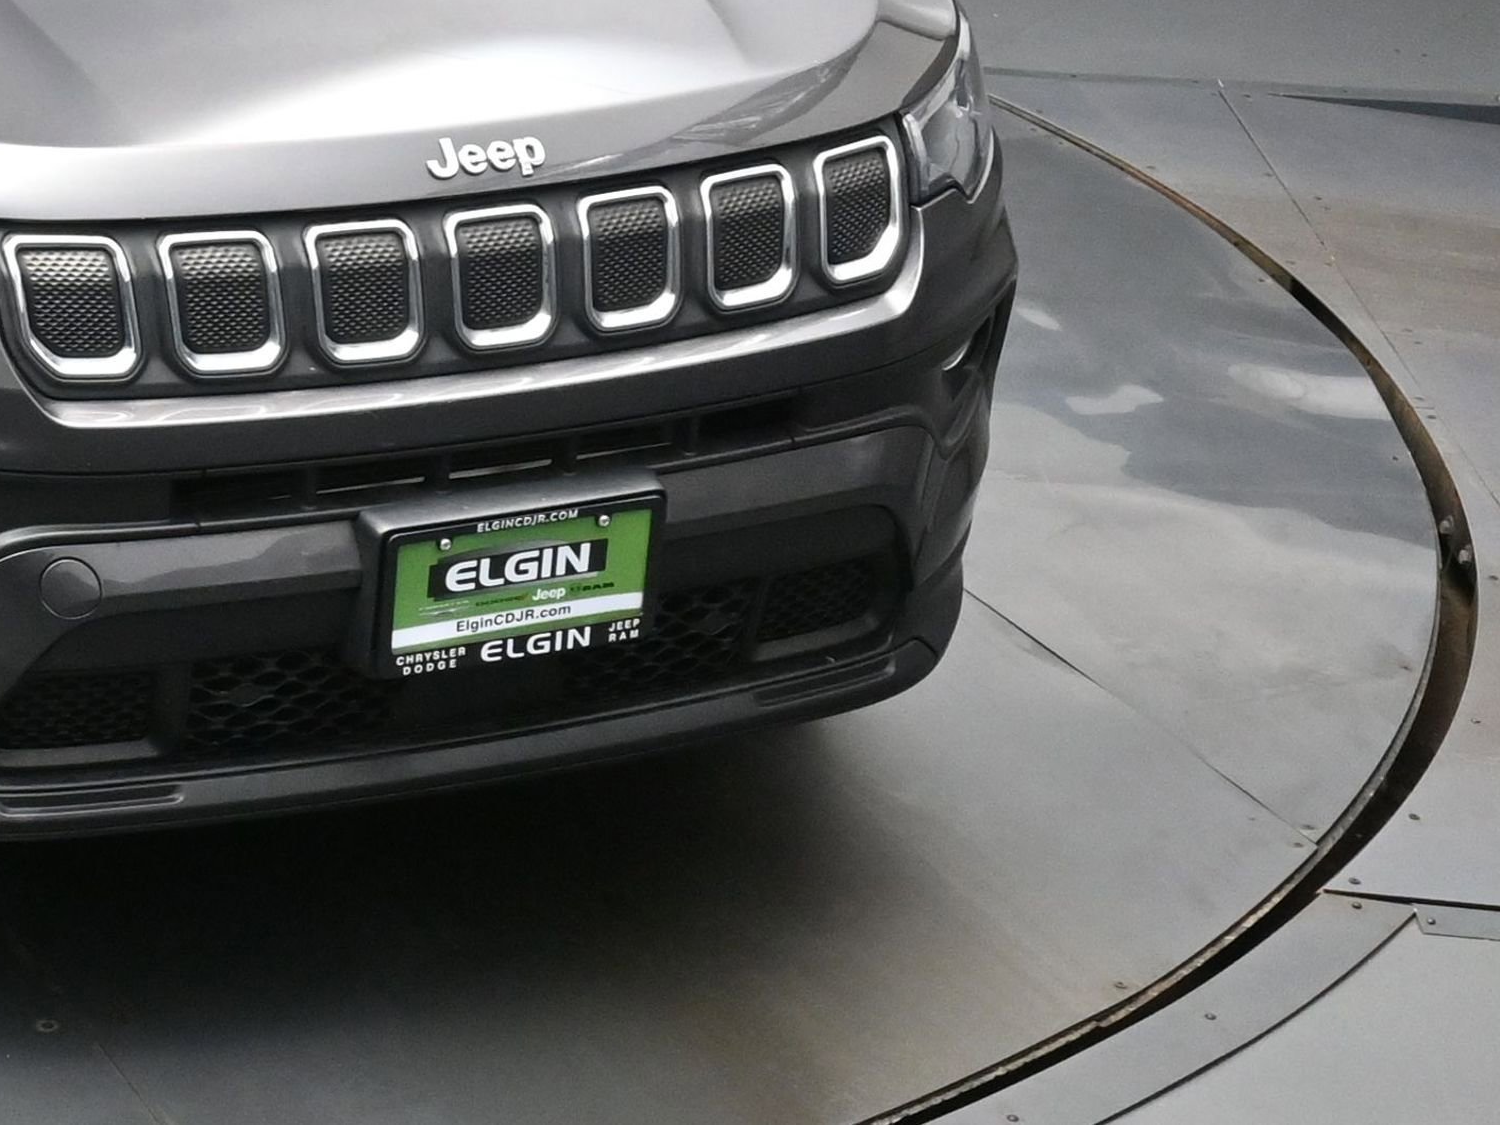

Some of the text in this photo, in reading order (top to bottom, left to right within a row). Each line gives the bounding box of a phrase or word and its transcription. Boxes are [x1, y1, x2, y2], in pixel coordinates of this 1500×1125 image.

[426, 136, 546, 179] Jeep
[476, 509, 579, 534] ELGINCDJR.COM
[445, 542, 592, 592] ELGIN
[531, 586, 566, 602] Jeep
[456, 604, 572, 634] ElginCDJR.com
[608, 618, 641, 633] JEEP
[480, 626, 591, 663] ELGIN
[608, 630, 640, 643] RAM
[395, 646, 467, 667] CHRYSLER
[402, 659, 458, 676] DODGE
